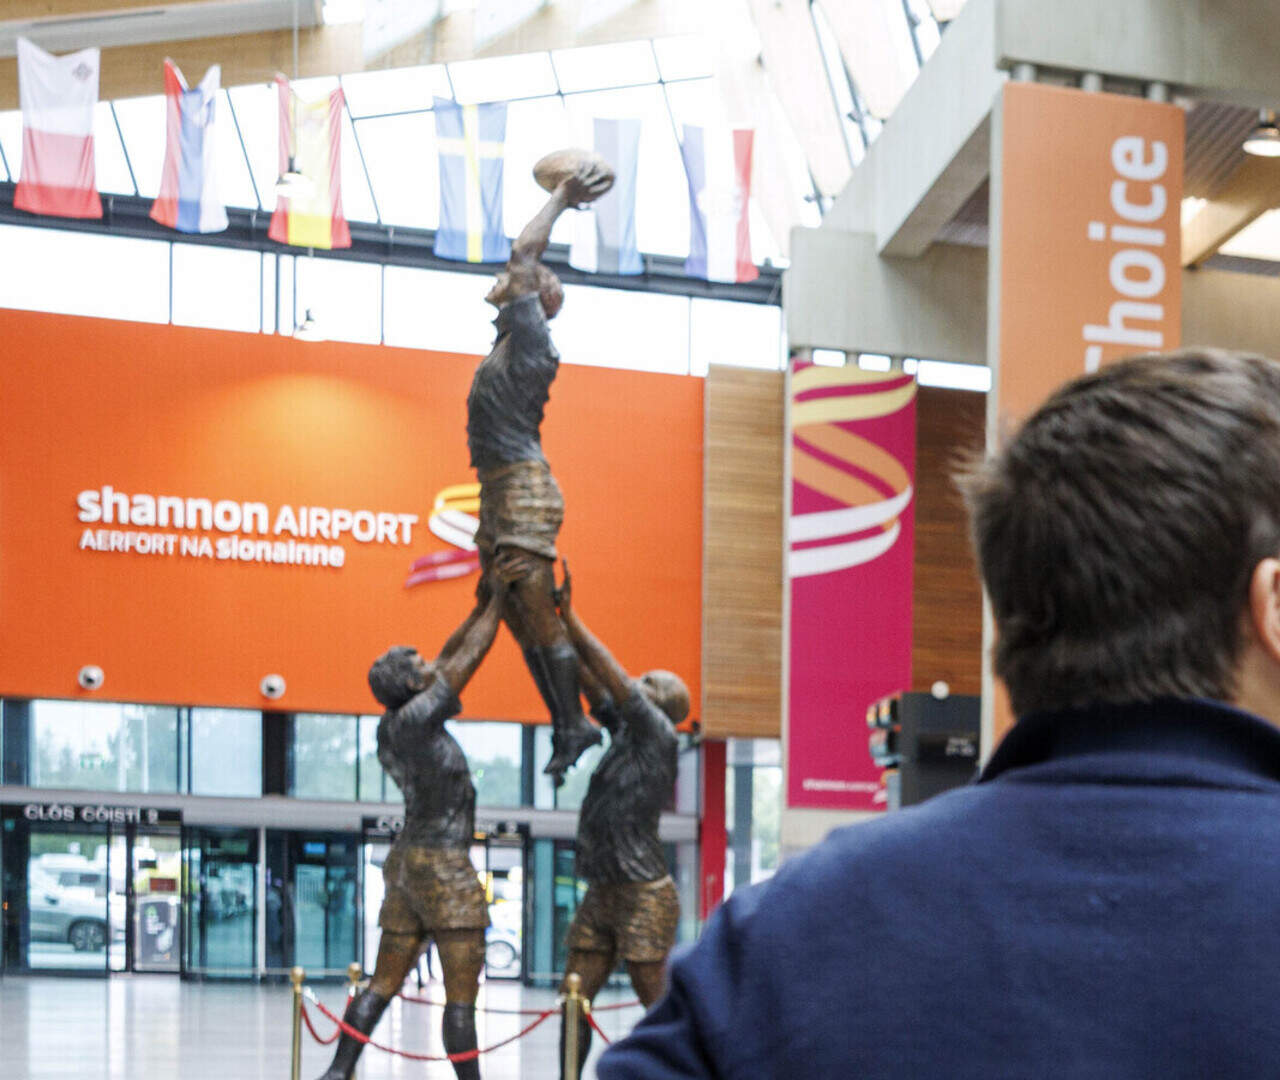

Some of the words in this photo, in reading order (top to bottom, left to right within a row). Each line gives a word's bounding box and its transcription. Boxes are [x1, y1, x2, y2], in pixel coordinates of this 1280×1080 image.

[77, 485, 269, 534] shannon
[274, 504, 418, 545] AIRPORT
[79, 528, 179, 555] AERFORT
[181, 534, 214, 558] NA
